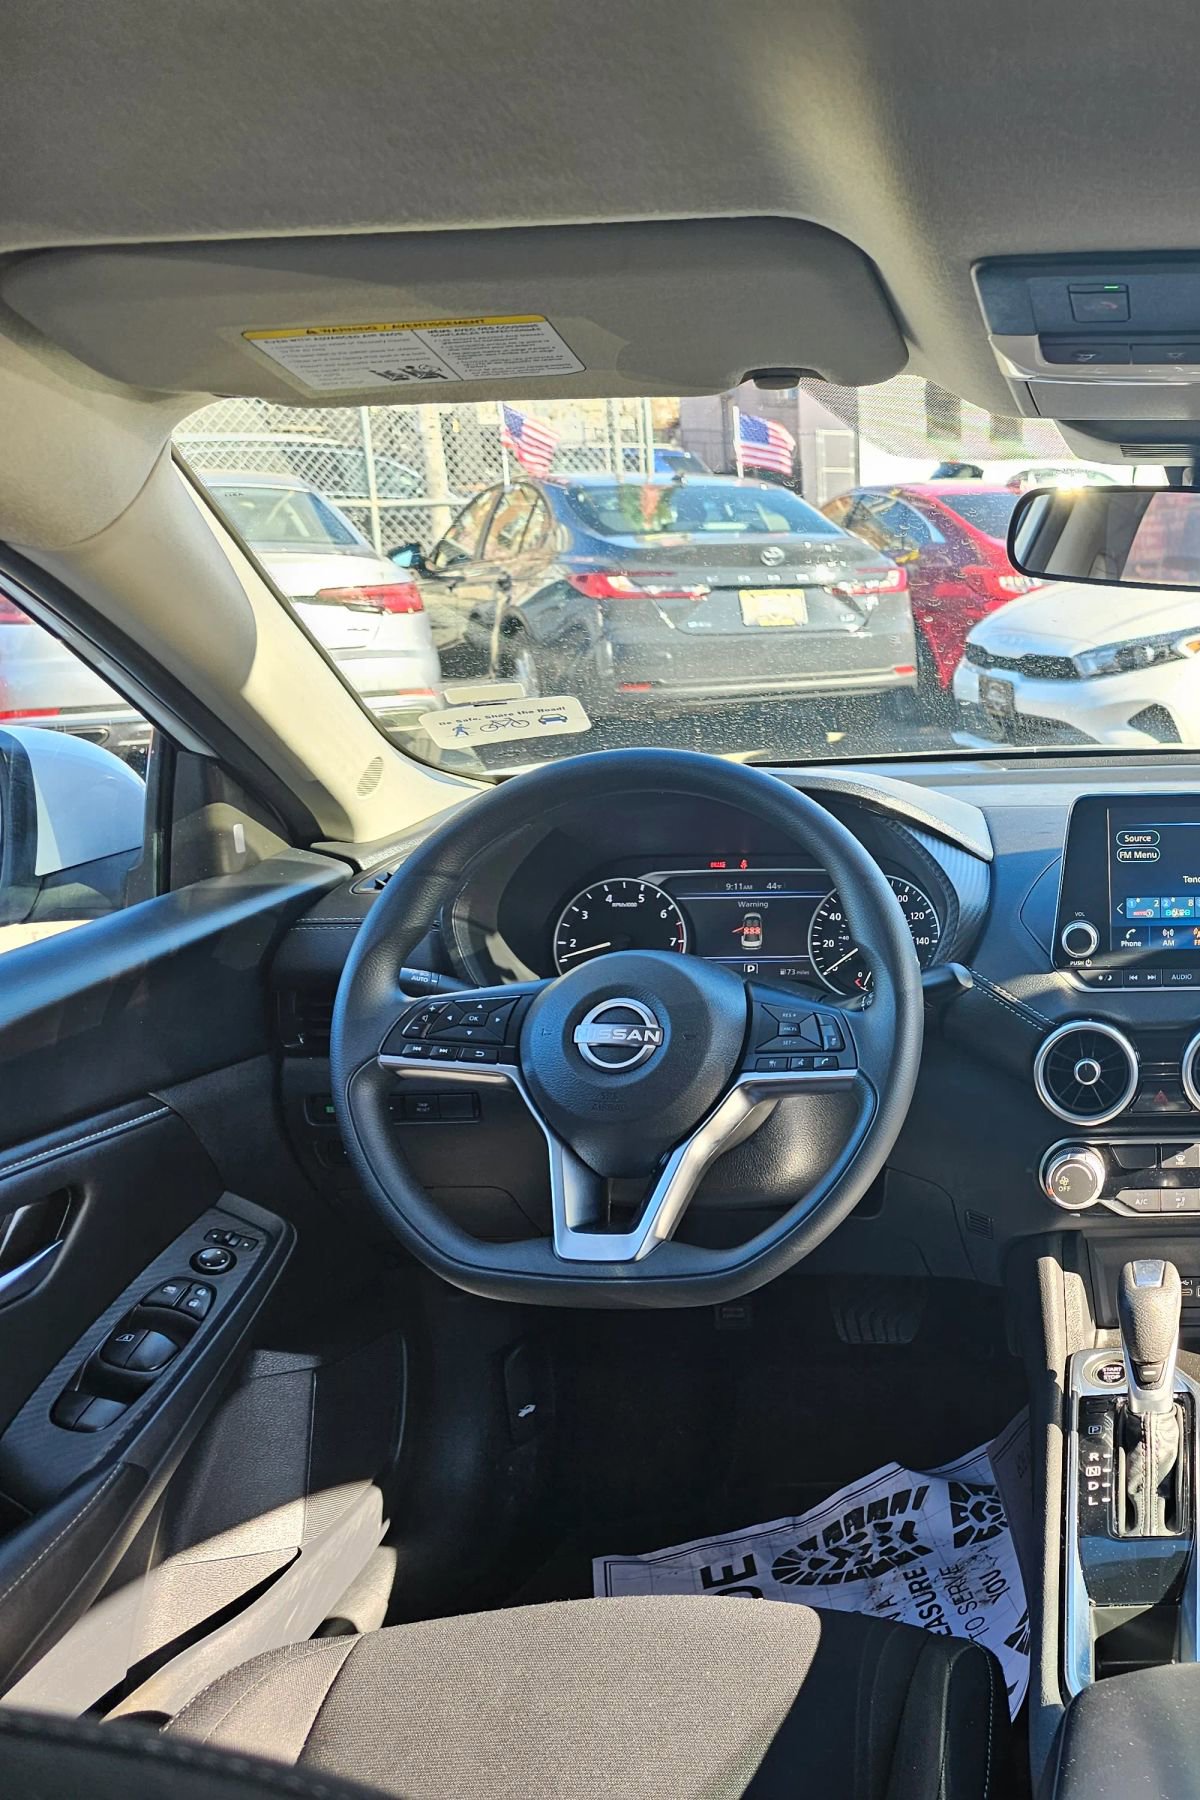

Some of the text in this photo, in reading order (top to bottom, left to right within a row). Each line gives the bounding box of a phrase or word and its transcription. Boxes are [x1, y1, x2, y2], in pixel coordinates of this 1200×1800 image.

[1124, 834, 1151, 843] Source
[1120, 851, 1157, 859] FM Menu
[605, 894, 613, 903] 4
[638, 894, 645, 903] 5
[738, 900, 769, 909] Warning
[581, 910, 588, 919] 3
[660, 910, 667, 919] 6
[829, 912, 841, 921] 40
[910, 912, 925, 920] 120
[569, 938, 577, 947] 2
[669, 937, 677, 946] 7
[822, 940, 834, 948] 20
[916, 937, 930, 945] 140
[786, 968, 796, 976] 73
[411, 975, 429, 983] AUTO
[468, 1014, 479, 1022] OK
[1058, 1185, 1071, 1193] OFF
[1135, 1197, 1149, 1206] A/C
[1088, 1452, 1100, 1462] R
[1088, 1481, 1100, 1491] D
[1088, 1496, 1099, 1506] L
[979, 1569, 1011, 1605] YOU
[964, 1616, 990, 1641] TO
